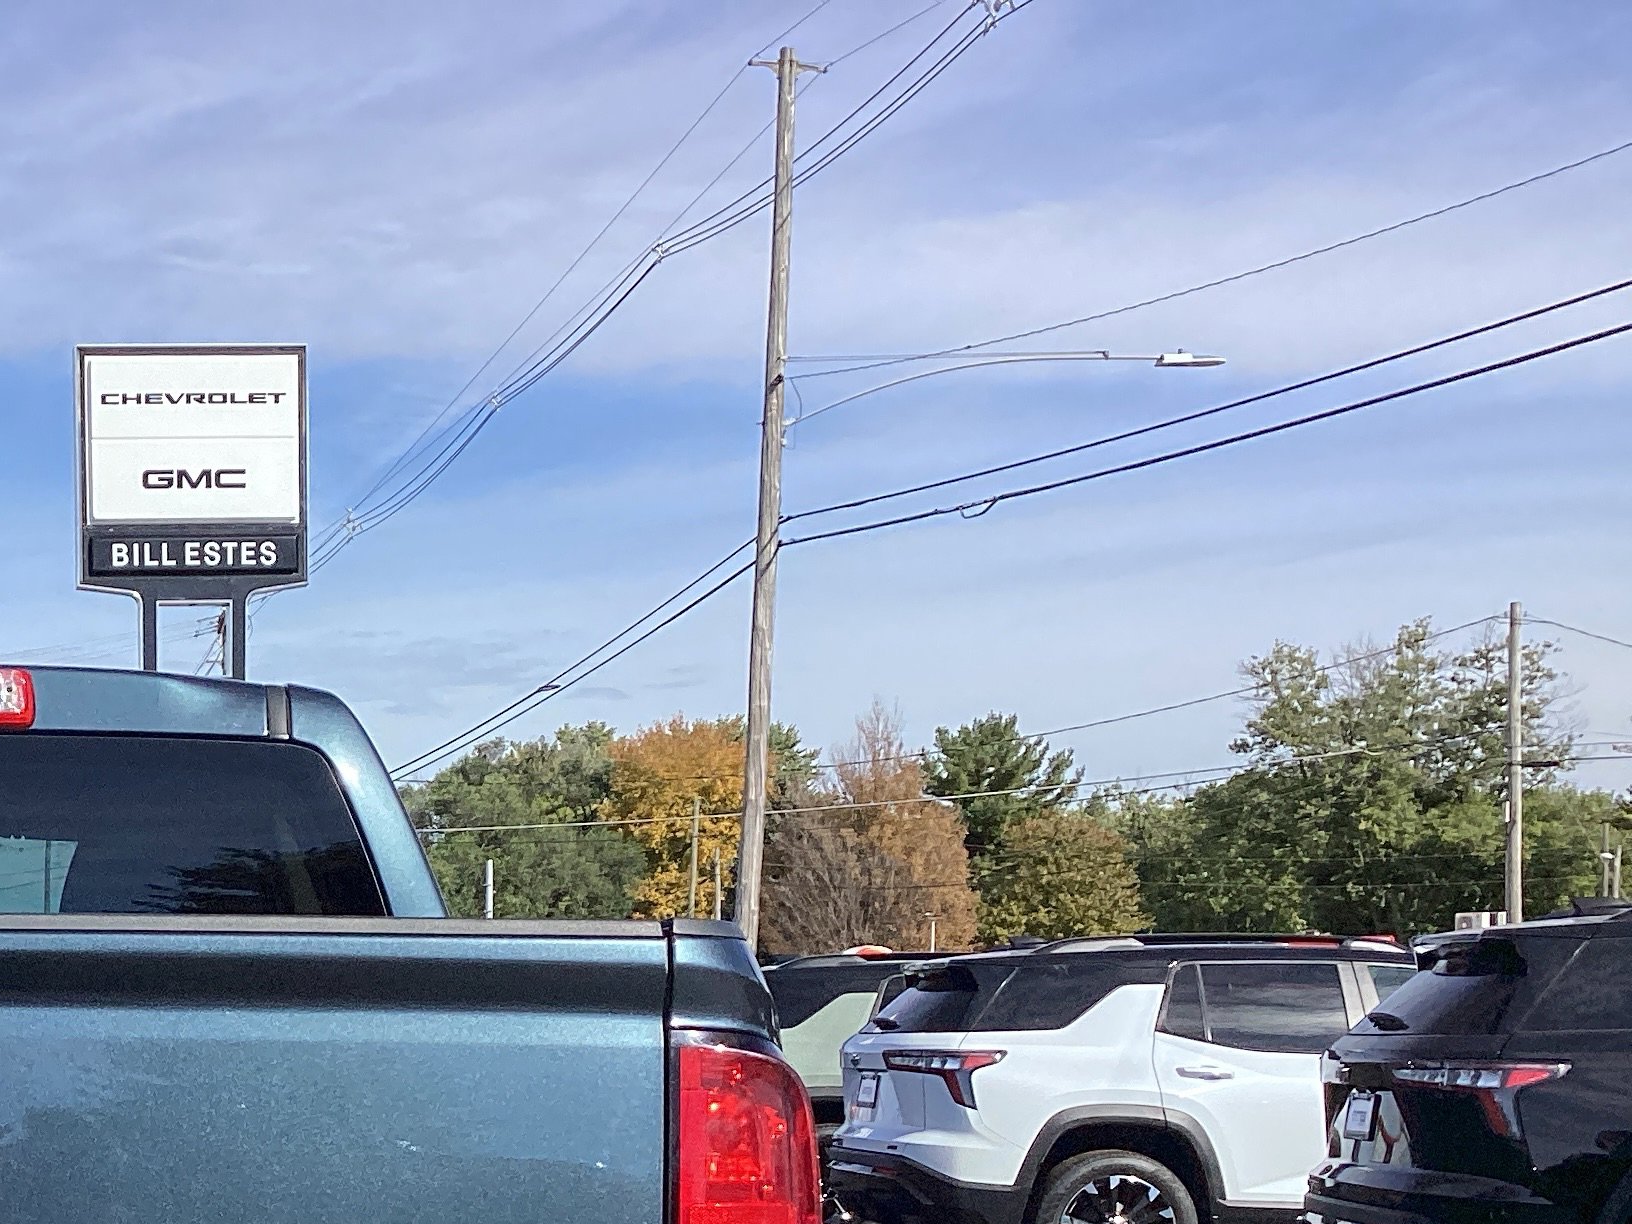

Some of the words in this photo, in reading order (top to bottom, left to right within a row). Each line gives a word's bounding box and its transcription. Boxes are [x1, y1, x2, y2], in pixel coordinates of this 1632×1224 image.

[100, 392, 286, 405] CHEVROLET
[142, 468, 246, 489] GMC
[111, 542, 177, 567] BILL
[184, 541, 277, 566] ESTES
